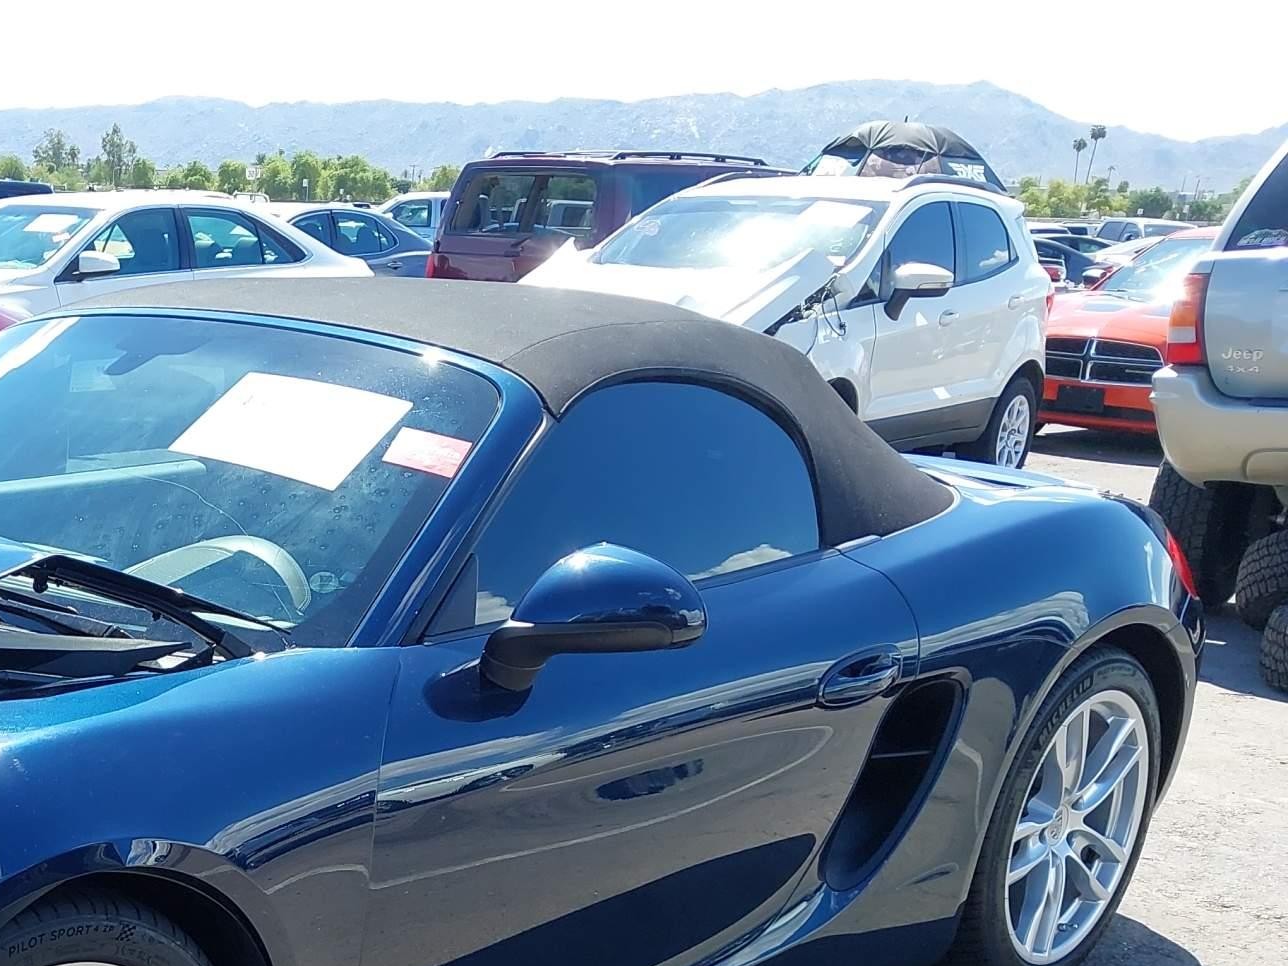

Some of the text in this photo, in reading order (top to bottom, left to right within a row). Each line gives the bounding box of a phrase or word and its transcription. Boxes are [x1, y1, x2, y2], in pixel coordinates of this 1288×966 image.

[1221, 347, 1264, 361] Jeep
[1038, 677, 1092, 747] MICHELIN
[8, 932, 47, 958] PILOT
[49, 924, 94, 941] SPORT
